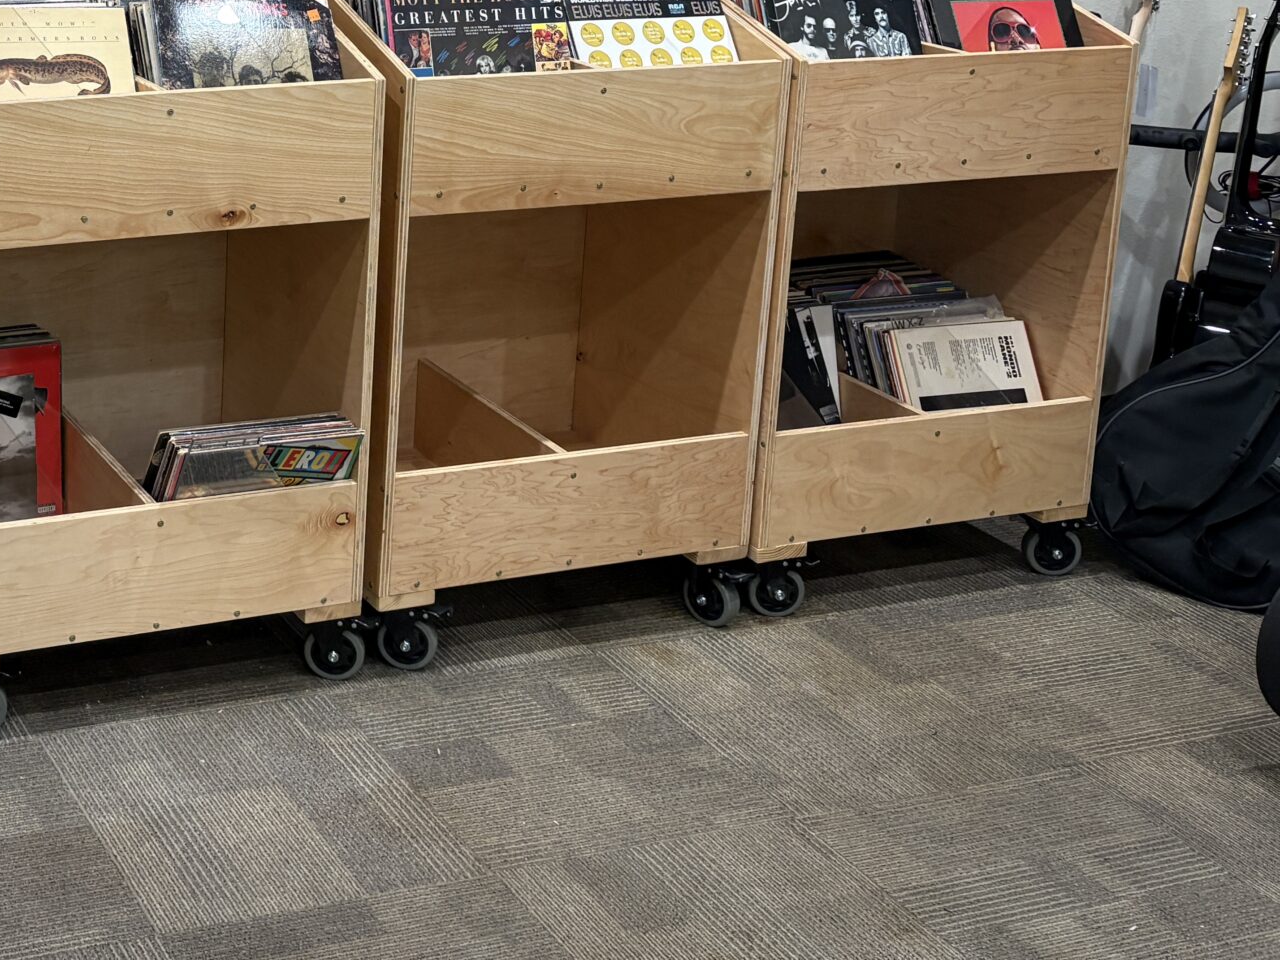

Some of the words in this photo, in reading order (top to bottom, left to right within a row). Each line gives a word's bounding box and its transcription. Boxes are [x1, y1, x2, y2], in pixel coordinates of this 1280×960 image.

[394, 9, 502, 25] GREATEST
[515, 6, 564, 20] HITS
[572, 5, 602, 19] ELVIS
[603, 4, 633, 18] ELVIS
[634, 3, 662, 17] ELVIS
[691, 1, 721, 15] ELVIS
